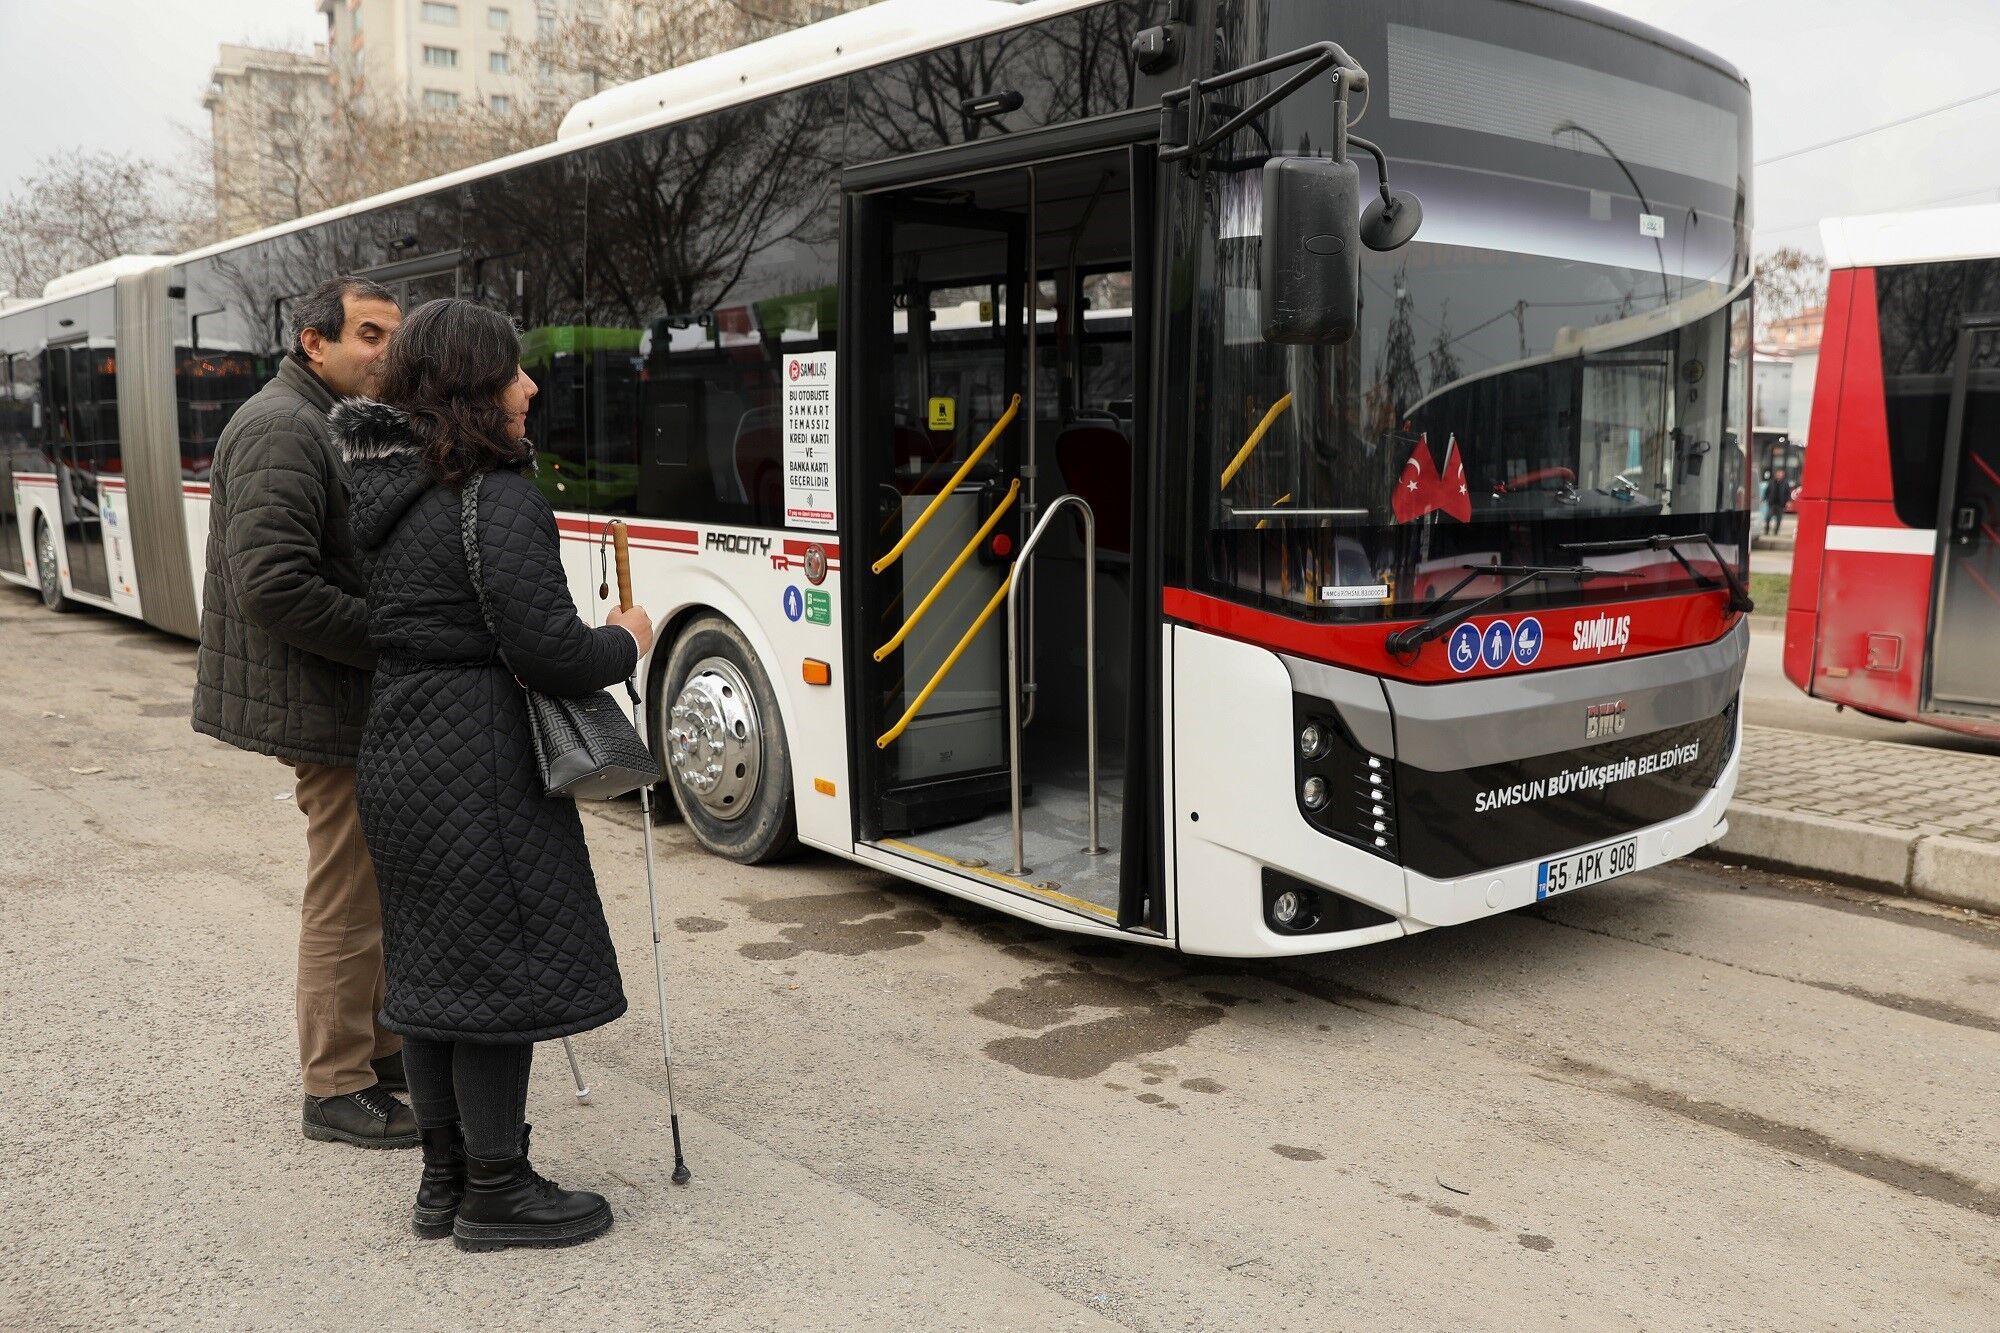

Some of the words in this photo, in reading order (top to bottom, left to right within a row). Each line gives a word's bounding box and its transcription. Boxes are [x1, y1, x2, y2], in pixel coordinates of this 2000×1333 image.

[789, 390, 798, 401] BU
[789, 405, 829, 416] SAMKART
[789, 419, 829, 430] TEMASSIZ
[810, 433, 829, 445] KARTI
[805, 447, 813, 458] VE
[790, 461, 810, 472] BANKA
[810, 461, 829, 473] KARTI
[705, 532, 772, 557] PROCITY
[770, 555, 789, 571] TR
[1585, 700, 1627, 739] BMC
[1474, 779, 1545, 813] SAMSUN
[1547, 756, 1636, 797] BÜYÜKŞEHİR
[1637, 738, 1700, 776] BELEDİYESİ
[1548, 861, 1568, 893] 55
[1575, 851, 1603, 885] APK
[1609, 842, 1635, 875] 908
